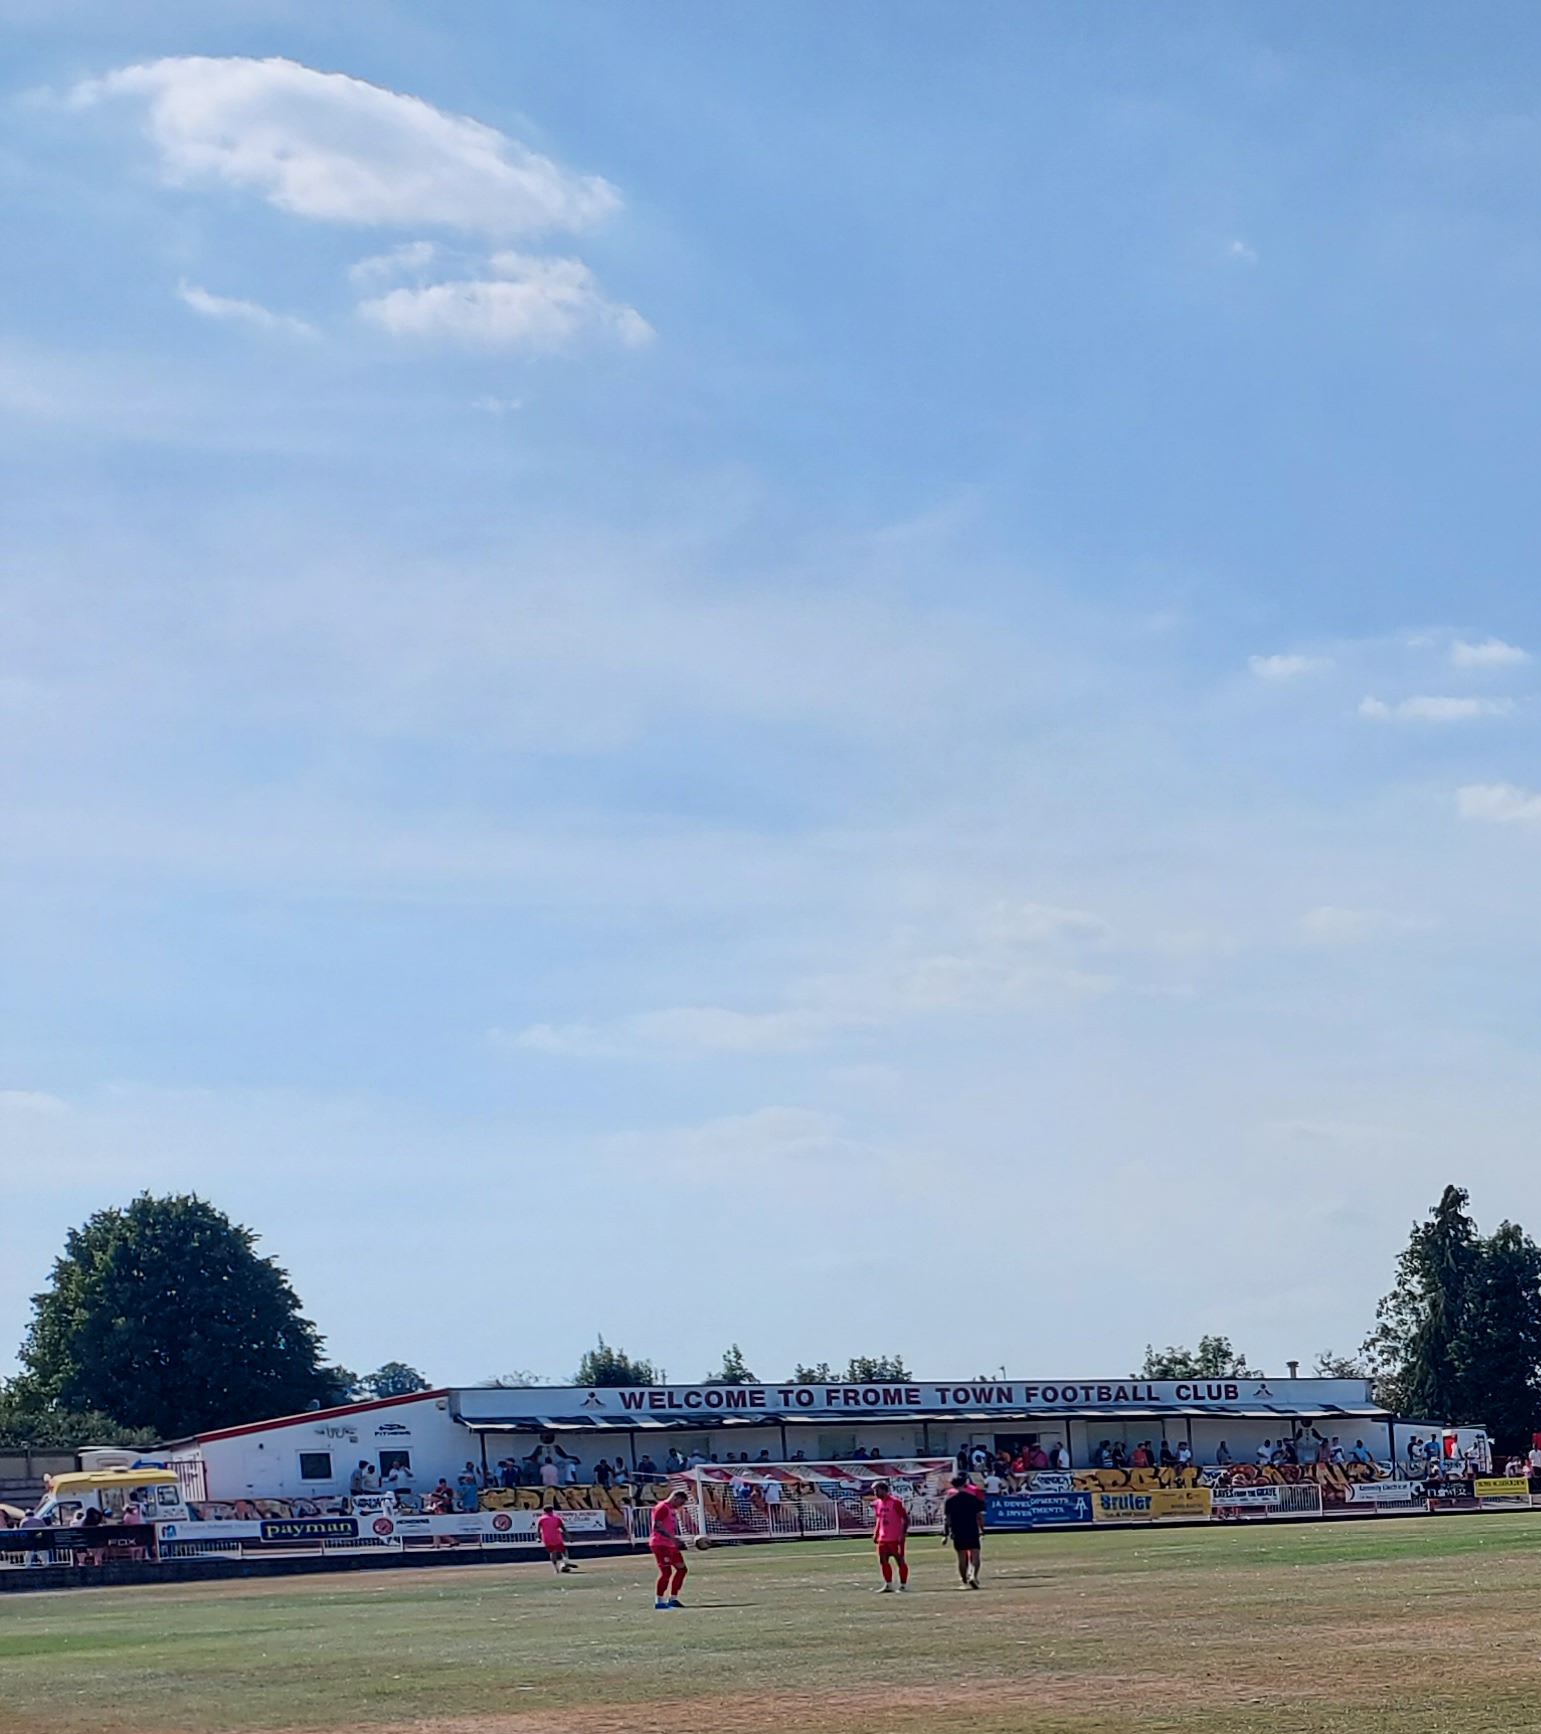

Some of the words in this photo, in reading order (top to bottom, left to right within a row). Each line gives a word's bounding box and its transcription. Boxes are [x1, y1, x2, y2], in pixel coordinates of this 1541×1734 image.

[618, 1389, 767, 1410] WELCOME
[777, 1388, 815, 1408] TO
[826, 1387, 922, 1407] FROME
[935, 1386, 1014, 1405] TOWN
[1025, 1384, 1161, 1404] FOOTBALL
[1175, 1383, 1240, 1402] CLUB
[1256, 1487, 1277, 1497] GRAVE
[1004, 1497, 1069, 1508] DEVELOPMENTS
[1006, 1506, 1065, 1517] INVESTMENTS
[264, 1521, 353, 1538] payman
[107, 1537, 137, 1546] FOX
